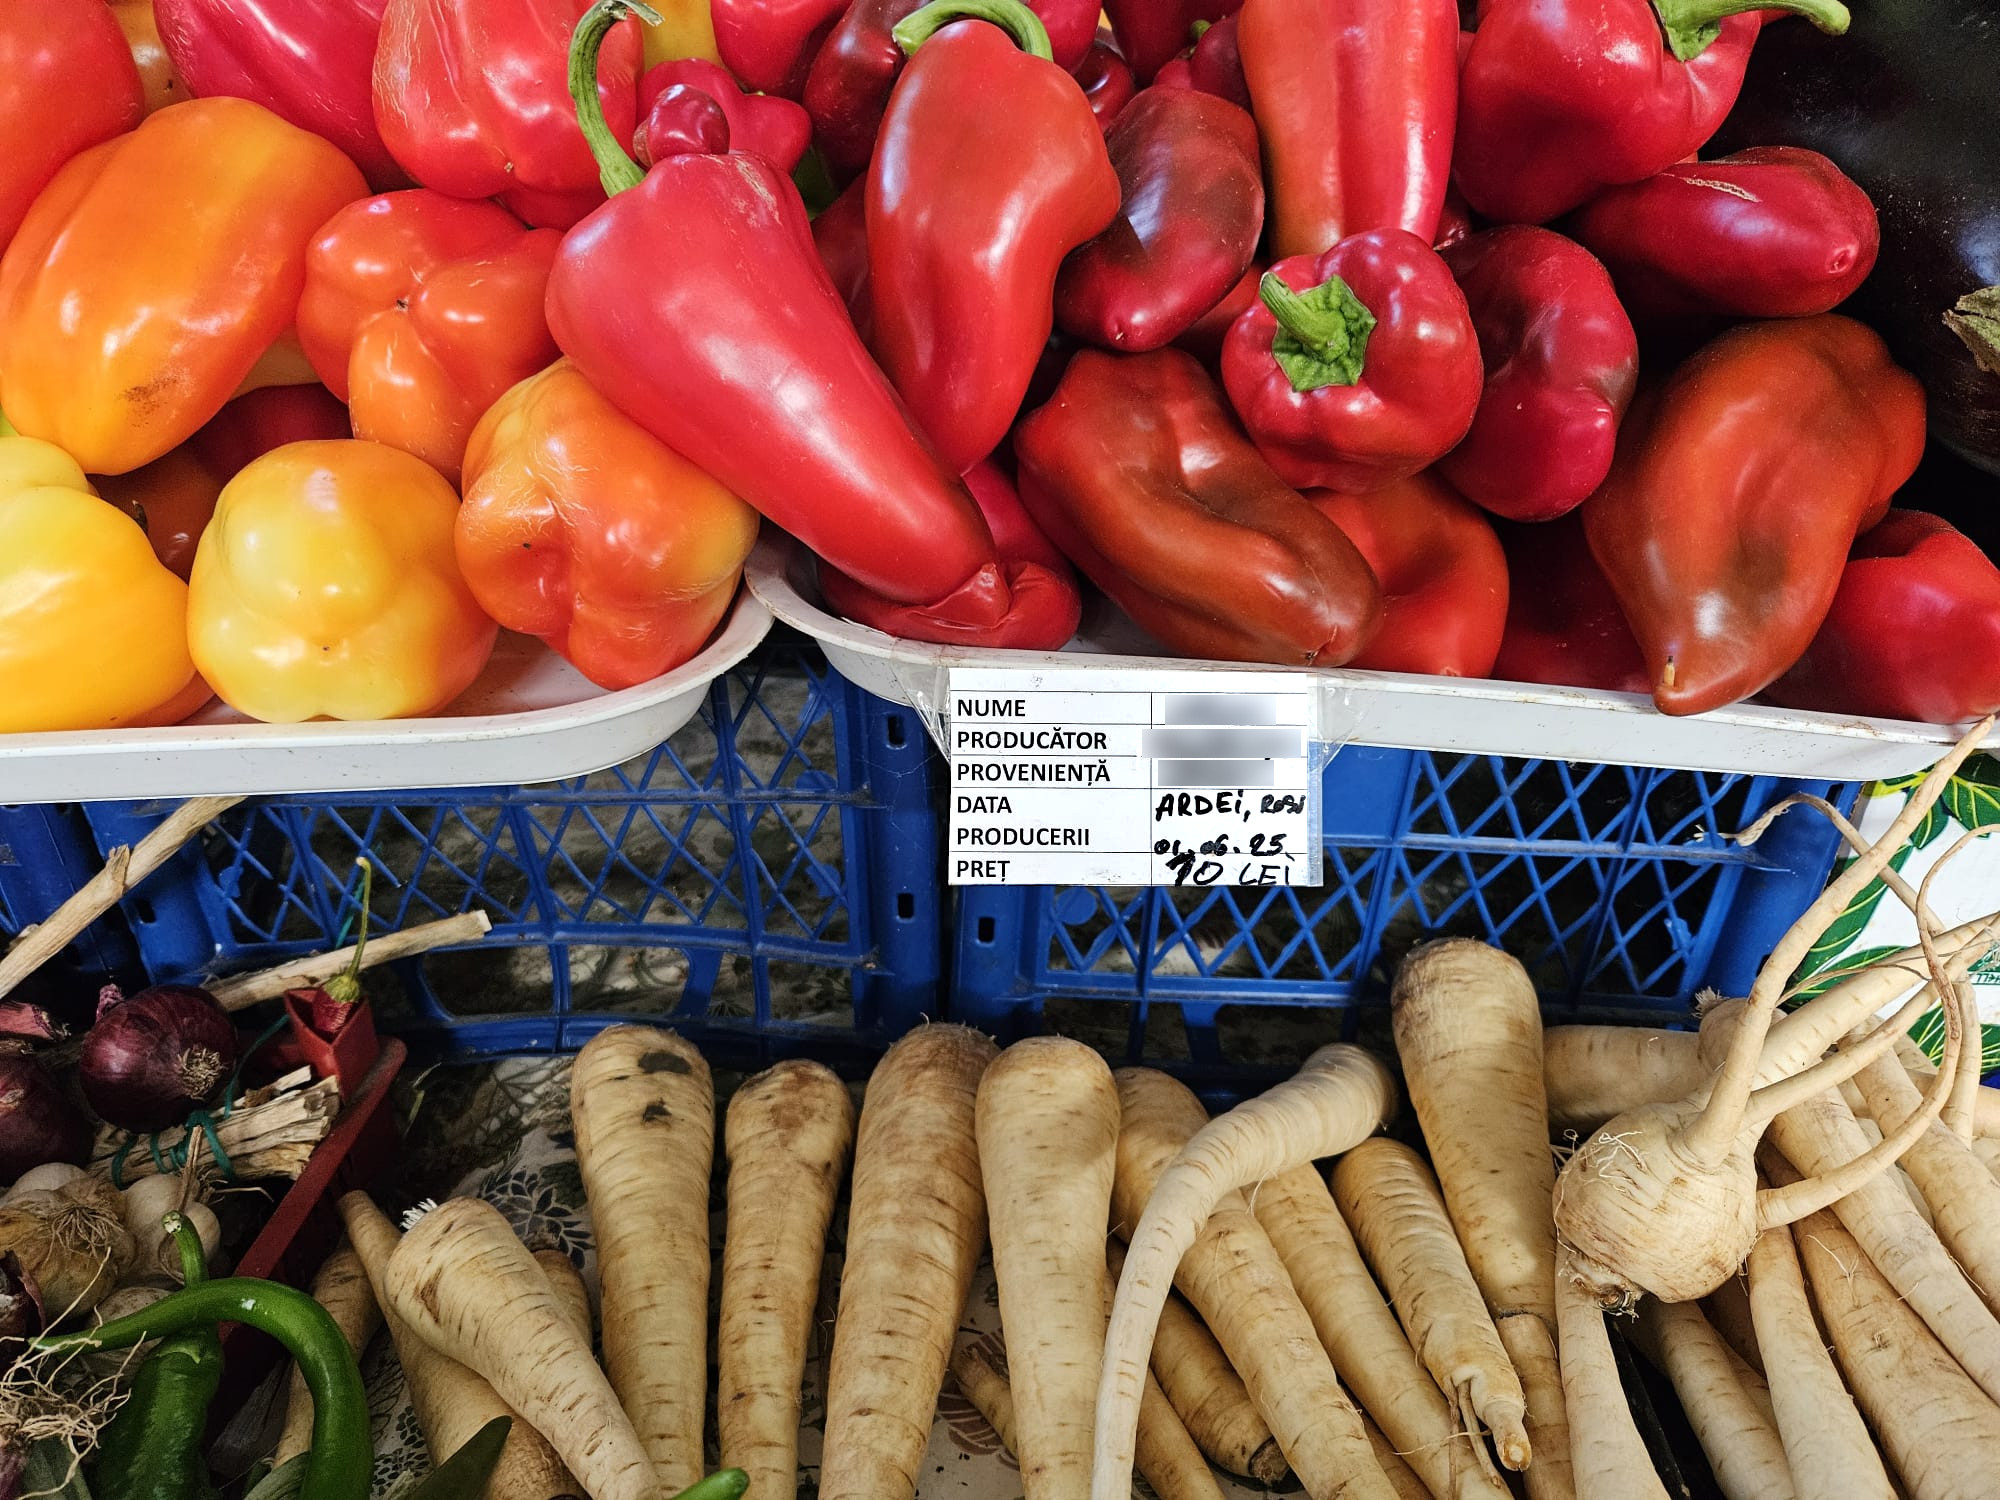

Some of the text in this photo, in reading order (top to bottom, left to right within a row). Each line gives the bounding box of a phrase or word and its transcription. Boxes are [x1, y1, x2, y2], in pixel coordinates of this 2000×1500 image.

[957, 699, 1026, 717] NUME
[957, 727, 1107, 750] PRODUCĂTOR
[957, 759, 1111, 787] PROVENIENȚĂ
[957, 796, 1012, 814] DATA
[957, 828, 1090, 846] PRODUCERII
[956, 860, 1011, 882] PREȚ
